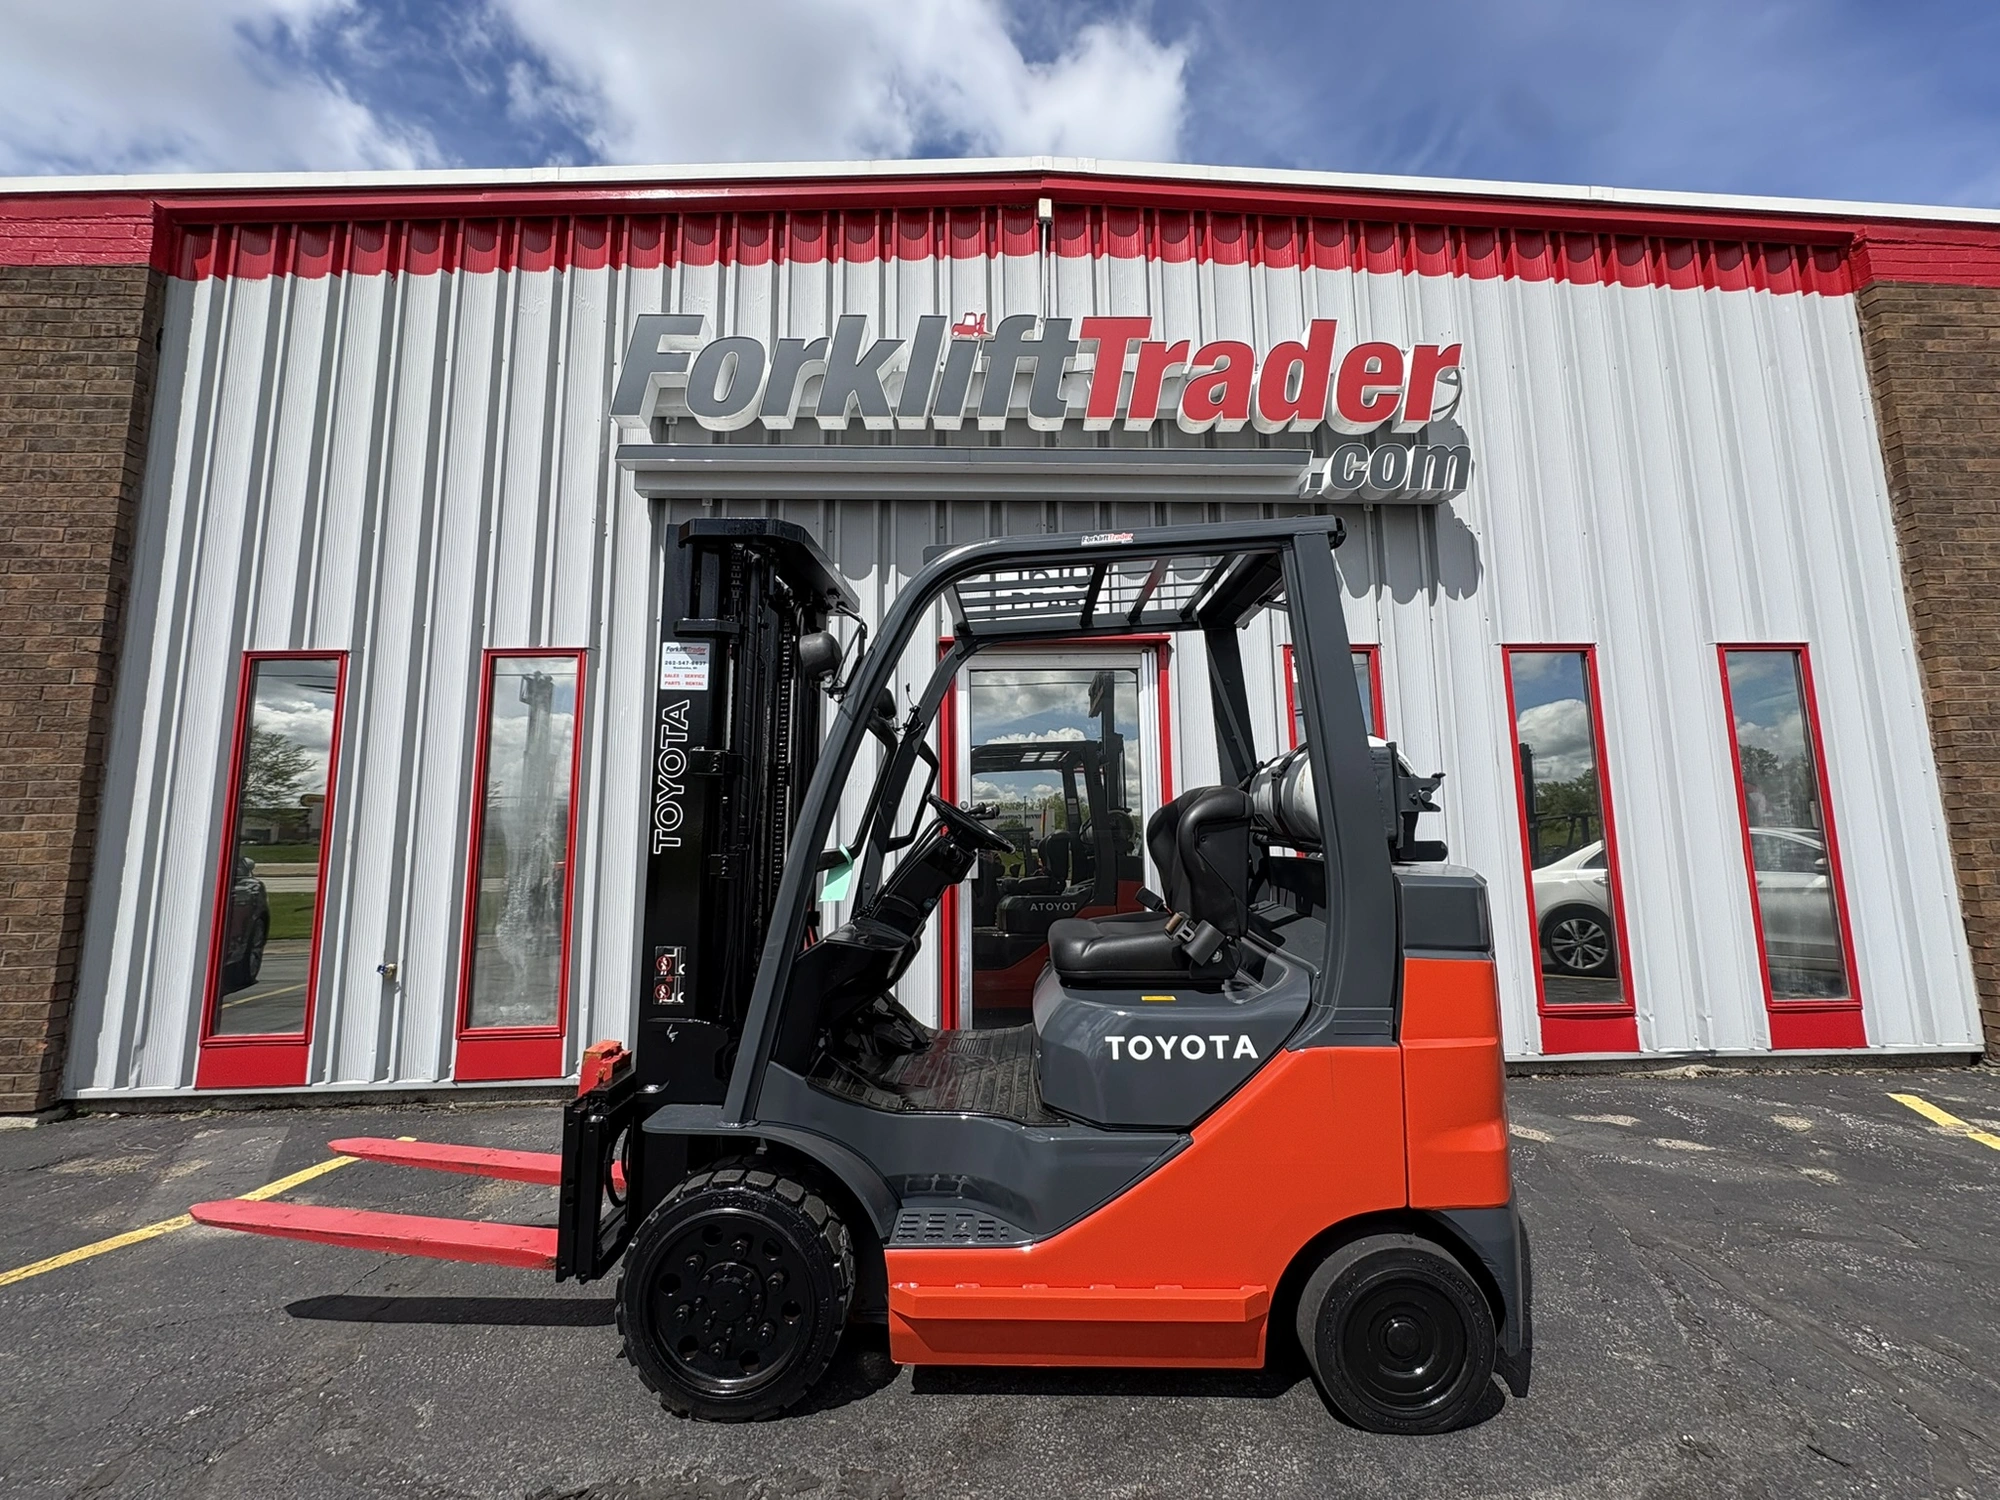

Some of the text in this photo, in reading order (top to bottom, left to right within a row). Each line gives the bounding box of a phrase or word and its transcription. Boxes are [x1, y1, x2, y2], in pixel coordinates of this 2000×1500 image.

[1306, 442, 1473, 492] .com
[653, 699, 690, 854] TOYOTA
[1105, 1034, 1259, 1060] TOYOTA
